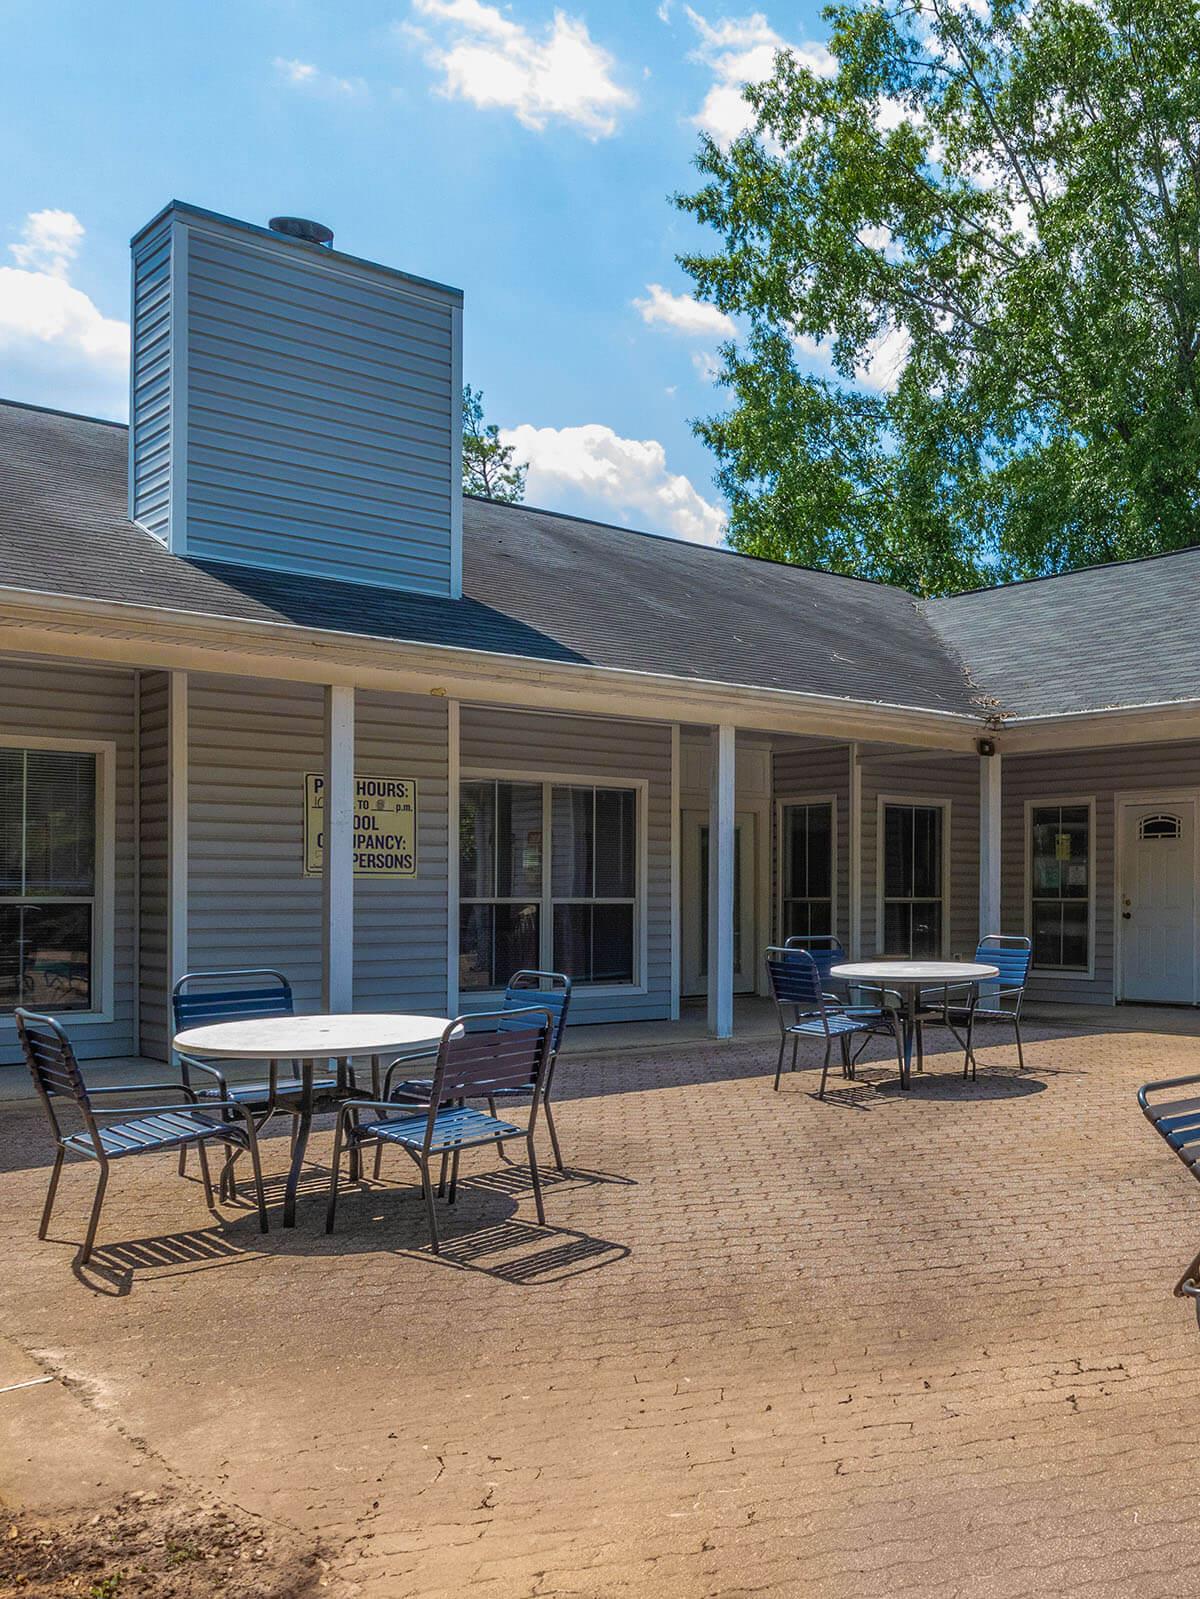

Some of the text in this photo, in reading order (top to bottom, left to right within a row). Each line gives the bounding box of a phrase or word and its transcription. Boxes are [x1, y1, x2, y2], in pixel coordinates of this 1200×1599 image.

[356, 781, 408, 798] HOURS:
[358, 800, 369, 810] TO
[396, 804, 413, 814] p.m.
[354, 816, 379, 830] OOL
